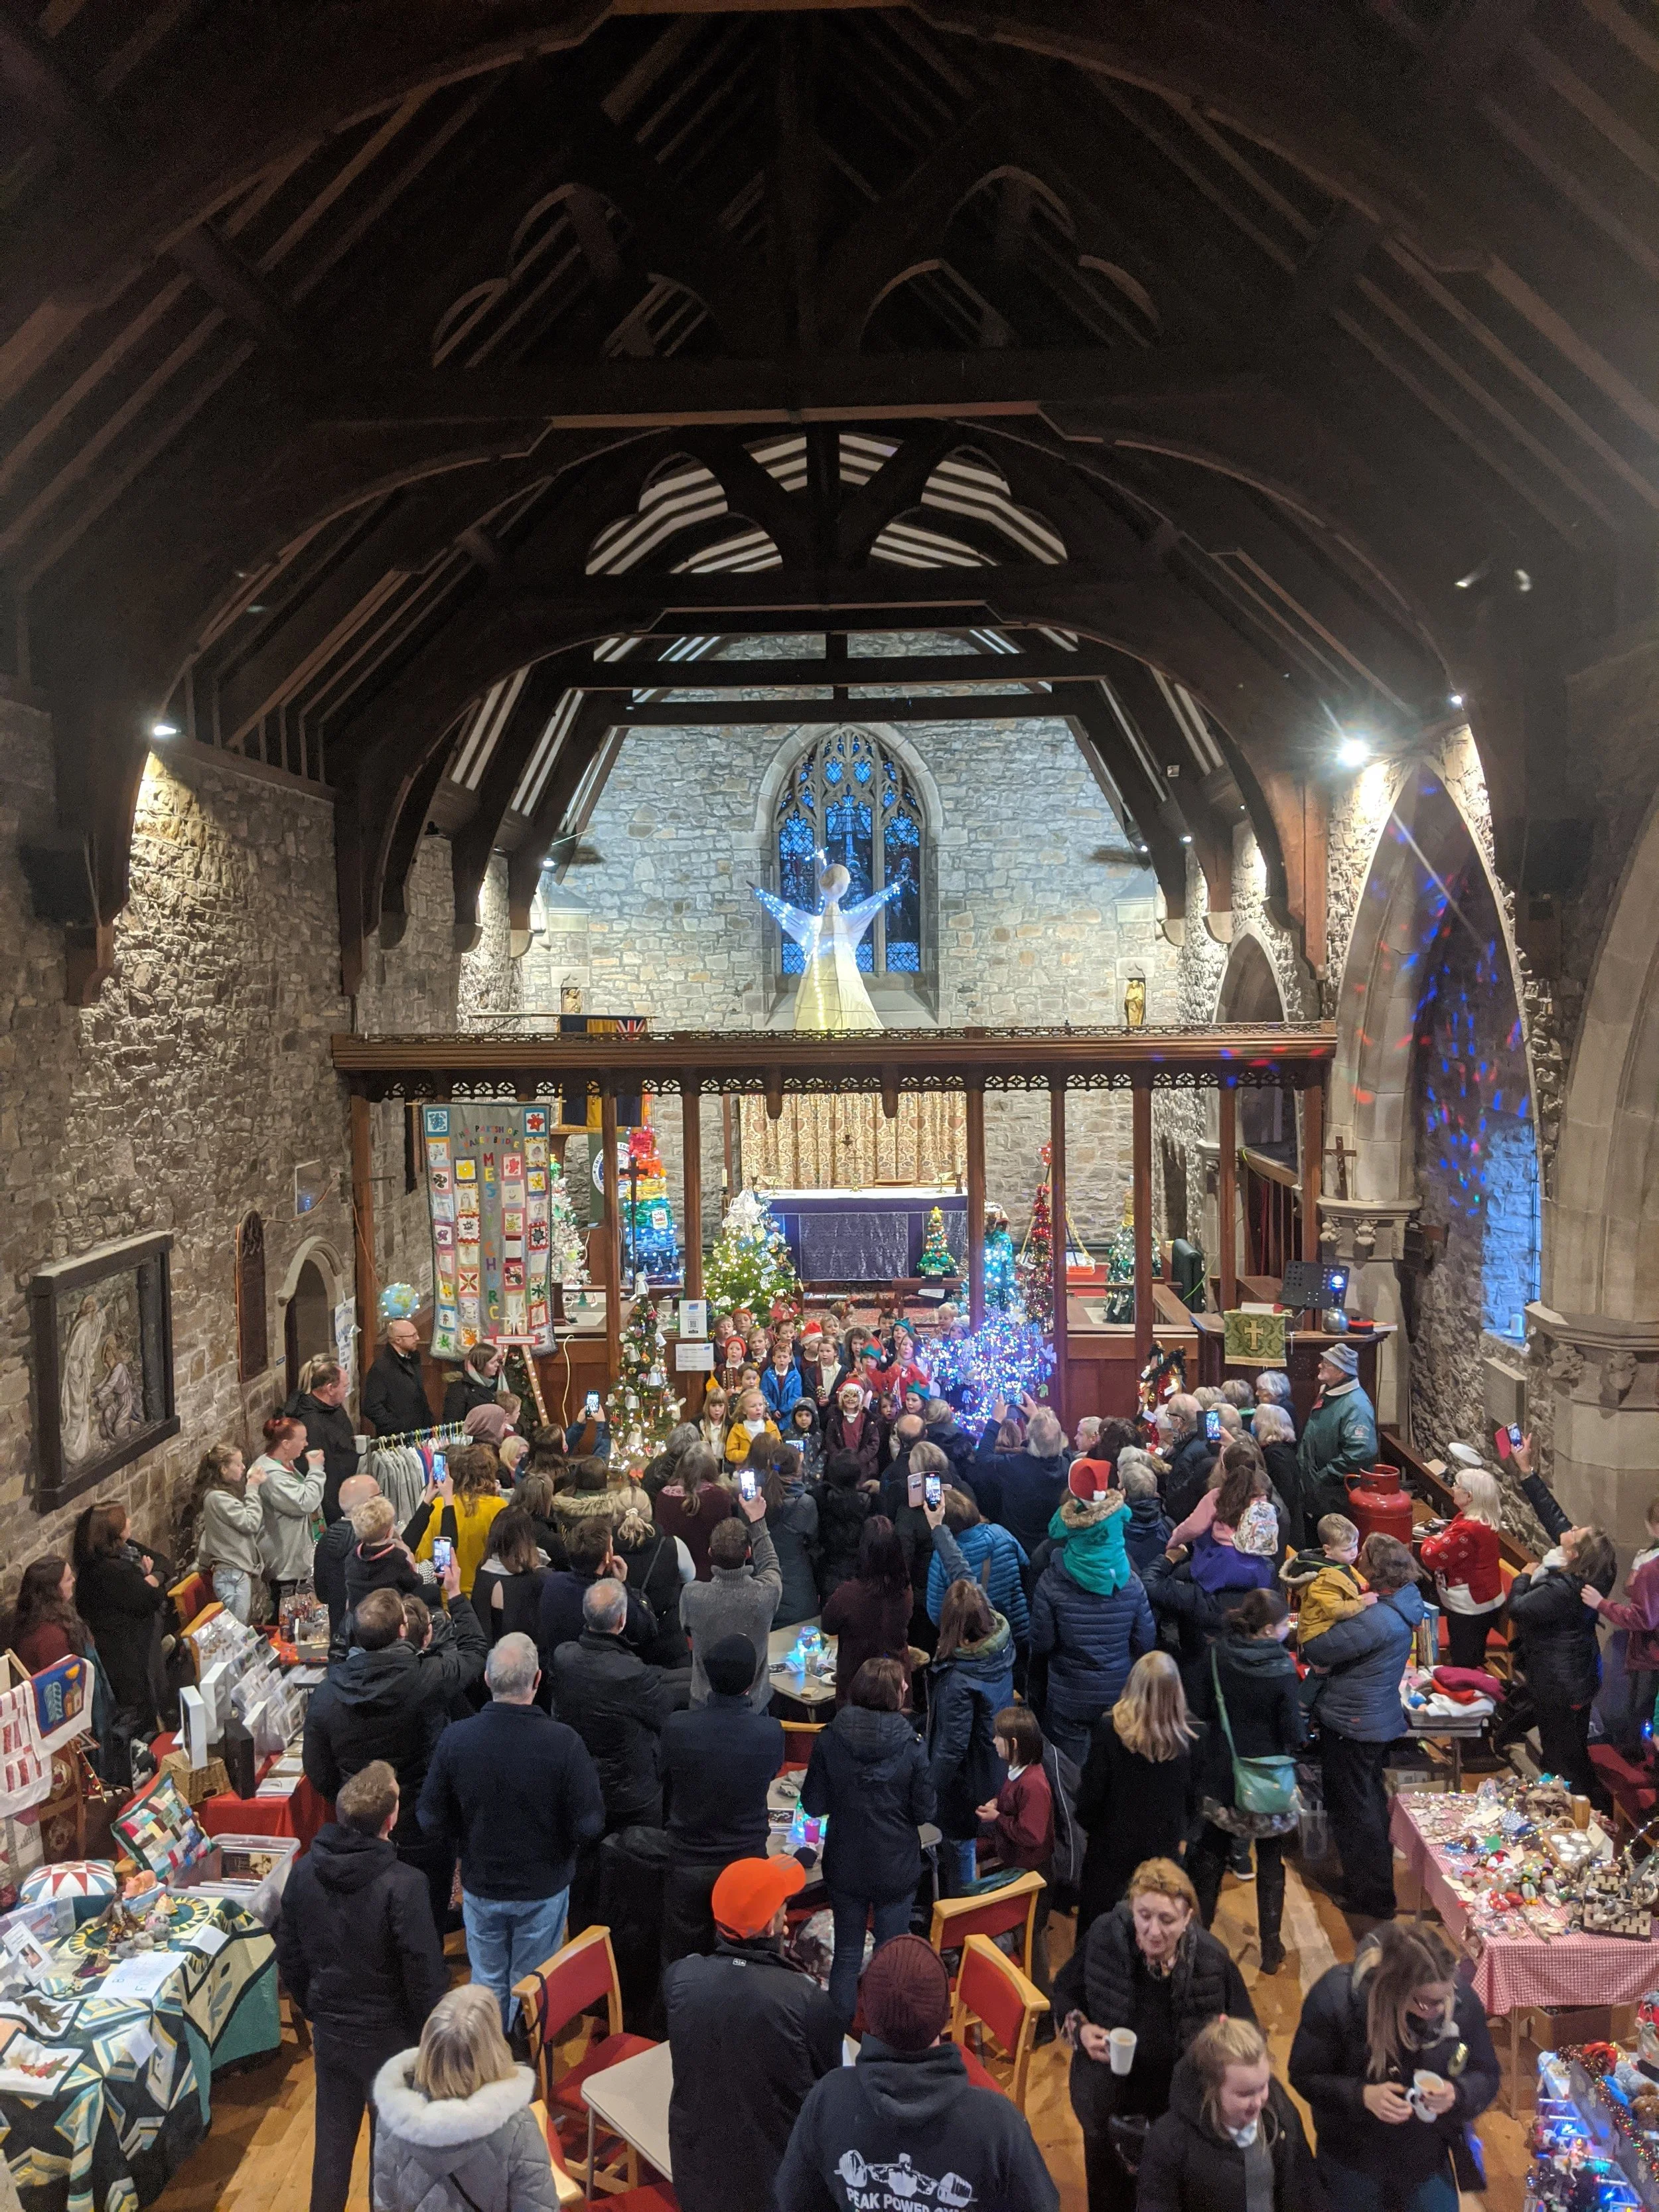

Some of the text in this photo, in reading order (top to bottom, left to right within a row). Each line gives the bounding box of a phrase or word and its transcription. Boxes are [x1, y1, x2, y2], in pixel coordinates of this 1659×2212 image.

[507, 1127, 519, 1137] OF
[493, 1136, 520, 1148] BRIDE
[483, 1152, 497, 1230] MESSY
[336, 1323, 354, 1342] UNIO
[846, 2187, 881, 2209] PEAK
